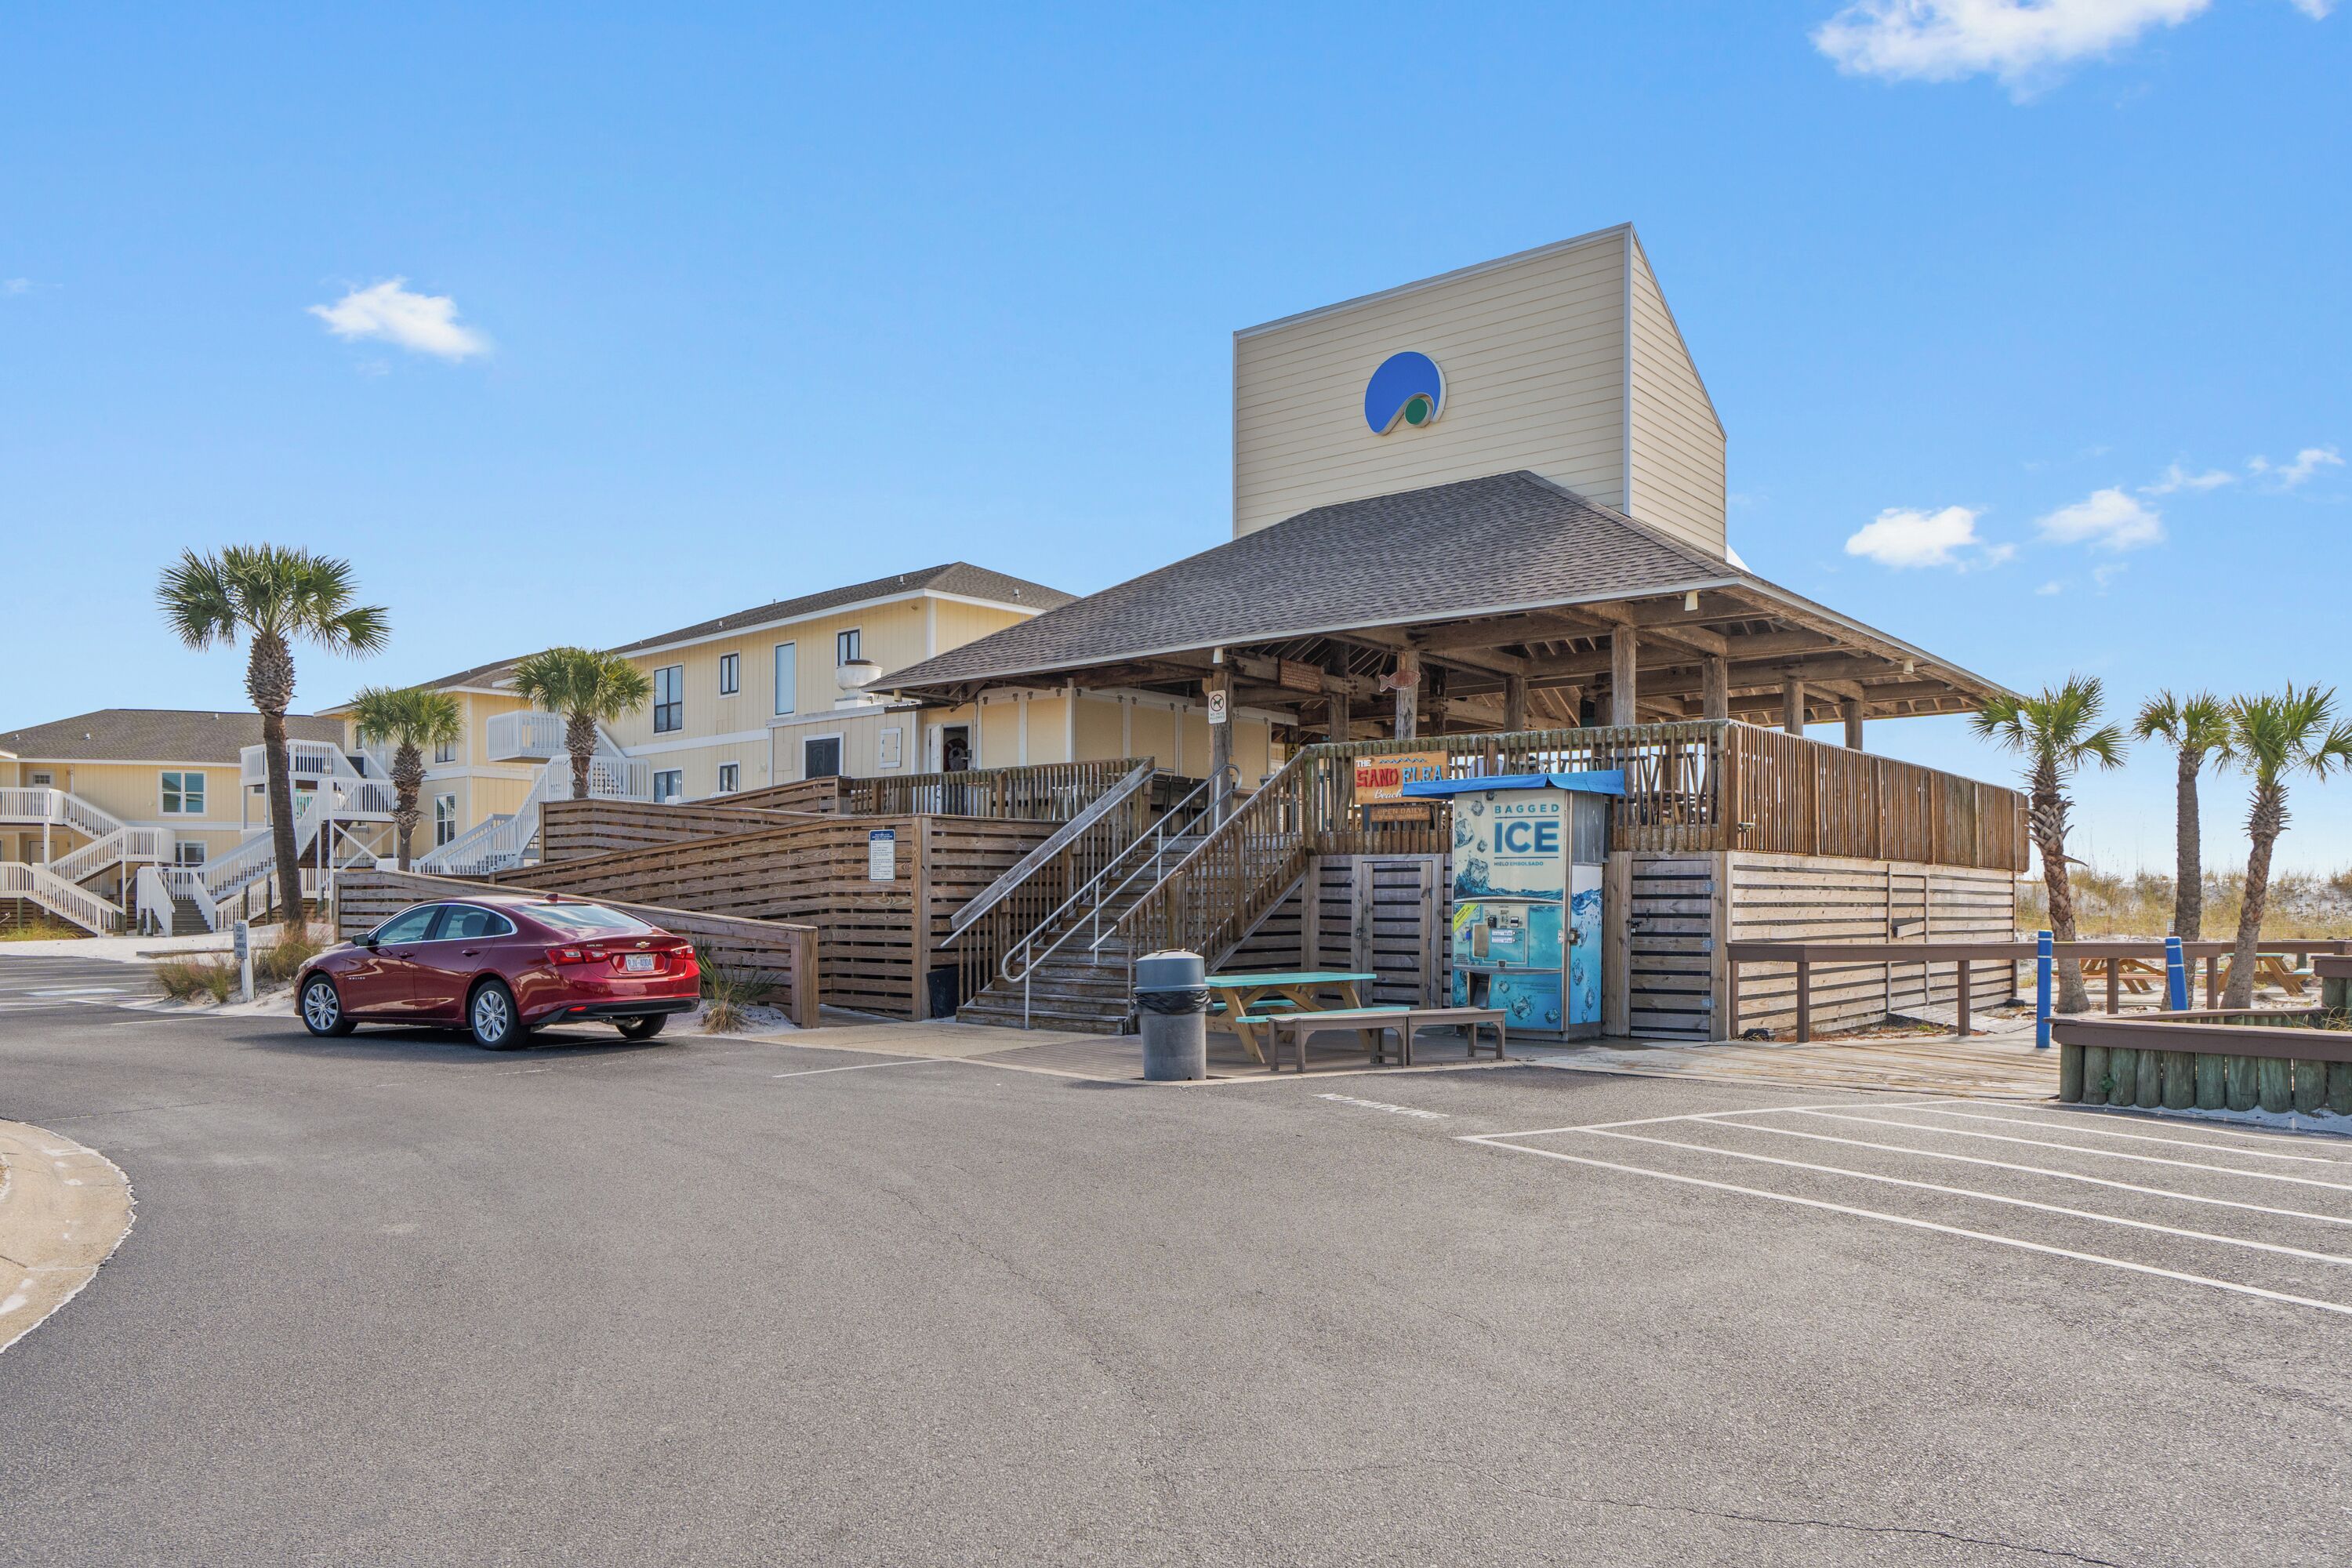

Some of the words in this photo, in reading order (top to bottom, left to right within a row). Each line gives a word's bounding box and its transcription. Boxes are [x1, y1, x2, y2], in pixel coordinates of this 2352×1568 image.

[1356, 768, 1399, 788] SAND
[1402, 764, 1443, 783] FLEA
[1374, 789, 1403, 799] Beach
[1494, 804, 1559, 814] BAGGED
[1494, 821, 1559, 853] ICE
